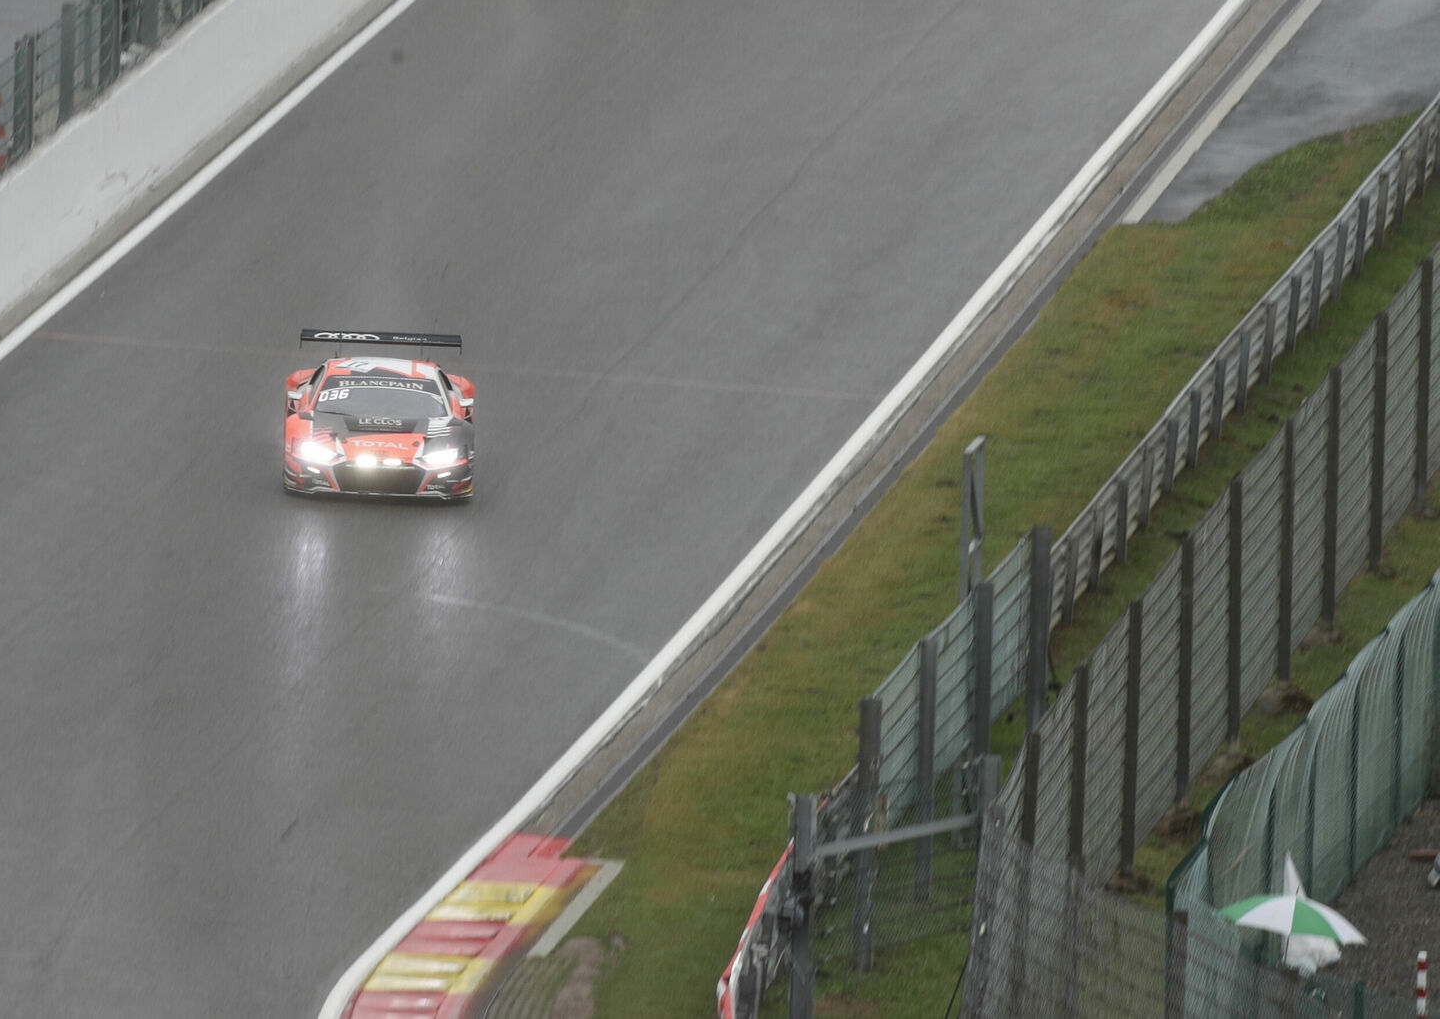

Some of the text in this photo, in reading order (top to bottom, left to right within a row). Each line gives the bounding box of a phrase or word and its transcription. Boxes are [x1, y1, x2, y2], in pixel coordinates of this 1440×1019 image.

[339, 380, 424, 391] BLANCPAIN
[318, 389, 350, 402] 036
[373, 418, 403, 426] CLOS
[351, 440, 409, 450] TOTAL
